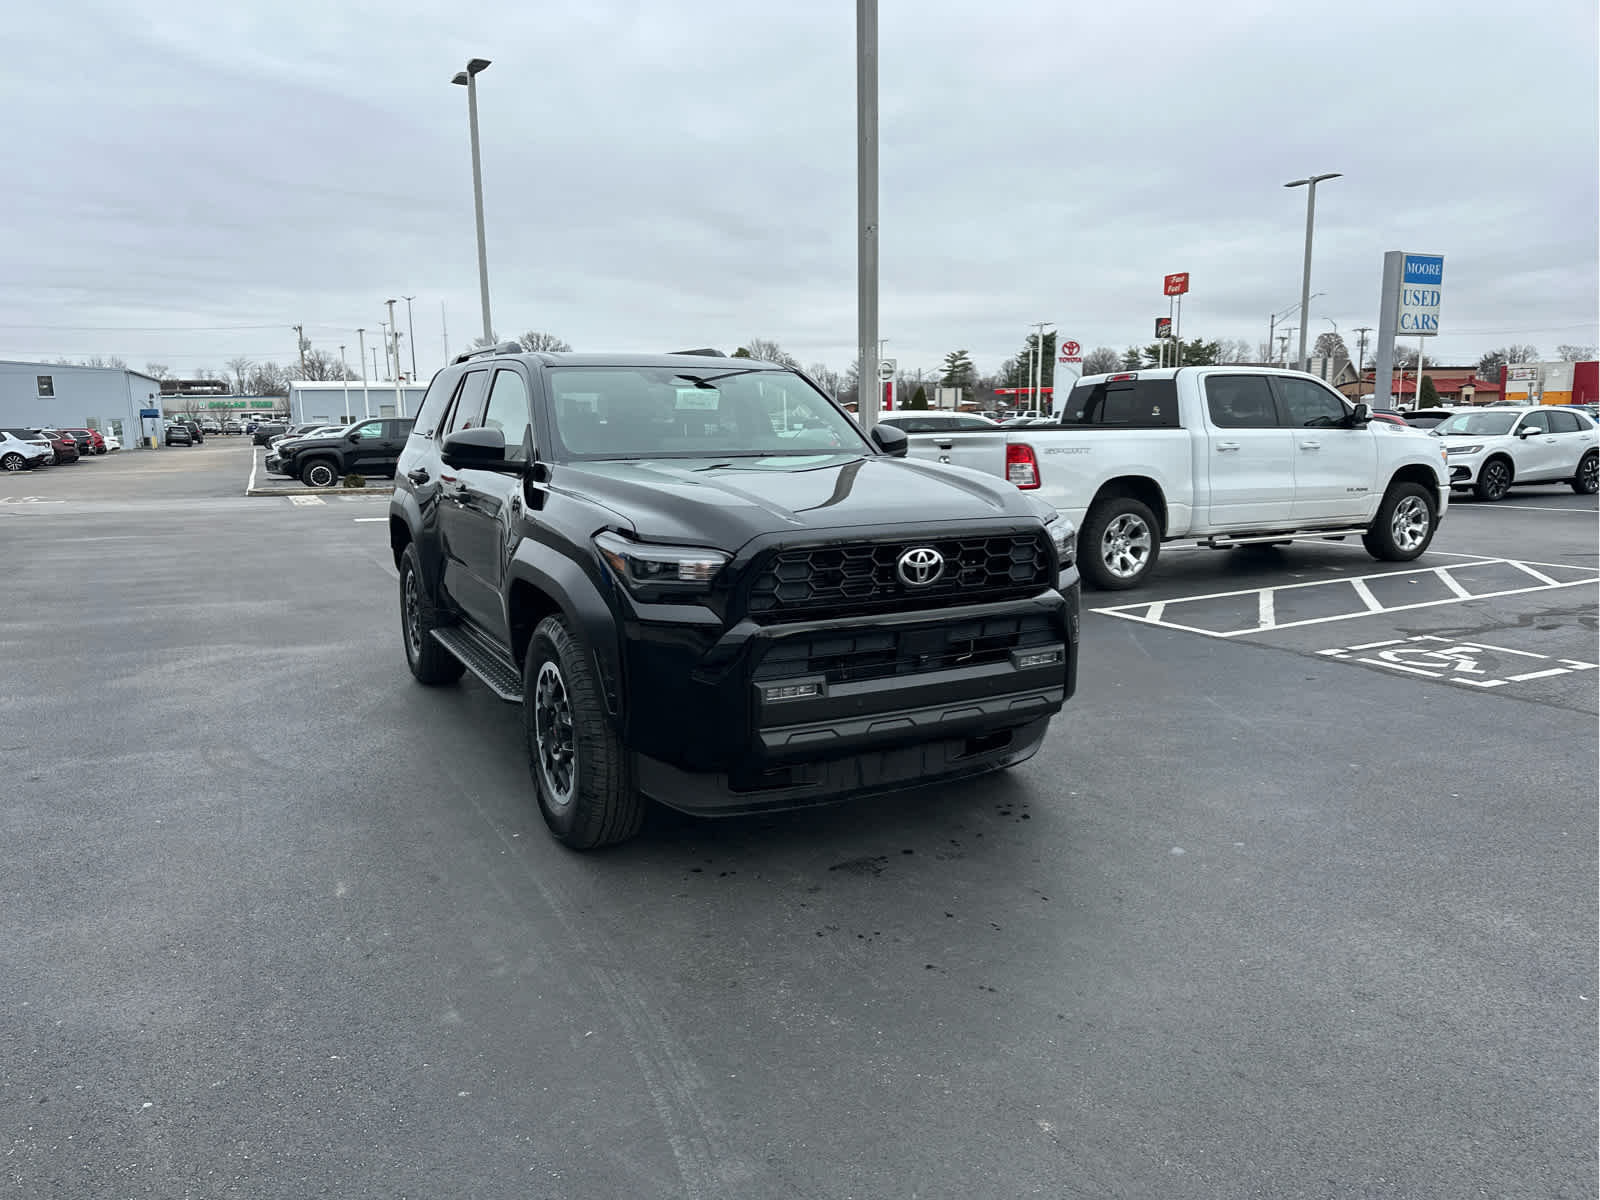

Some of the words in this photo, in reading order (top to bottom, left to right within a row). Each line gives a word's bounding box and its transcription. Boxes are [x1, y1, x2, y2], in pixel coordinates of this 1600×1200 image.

[1407, 262, 1441, 275] MOORE
[1403, 289, 1441, 307] USED
[1401, 312, 1439, 330] CARS
